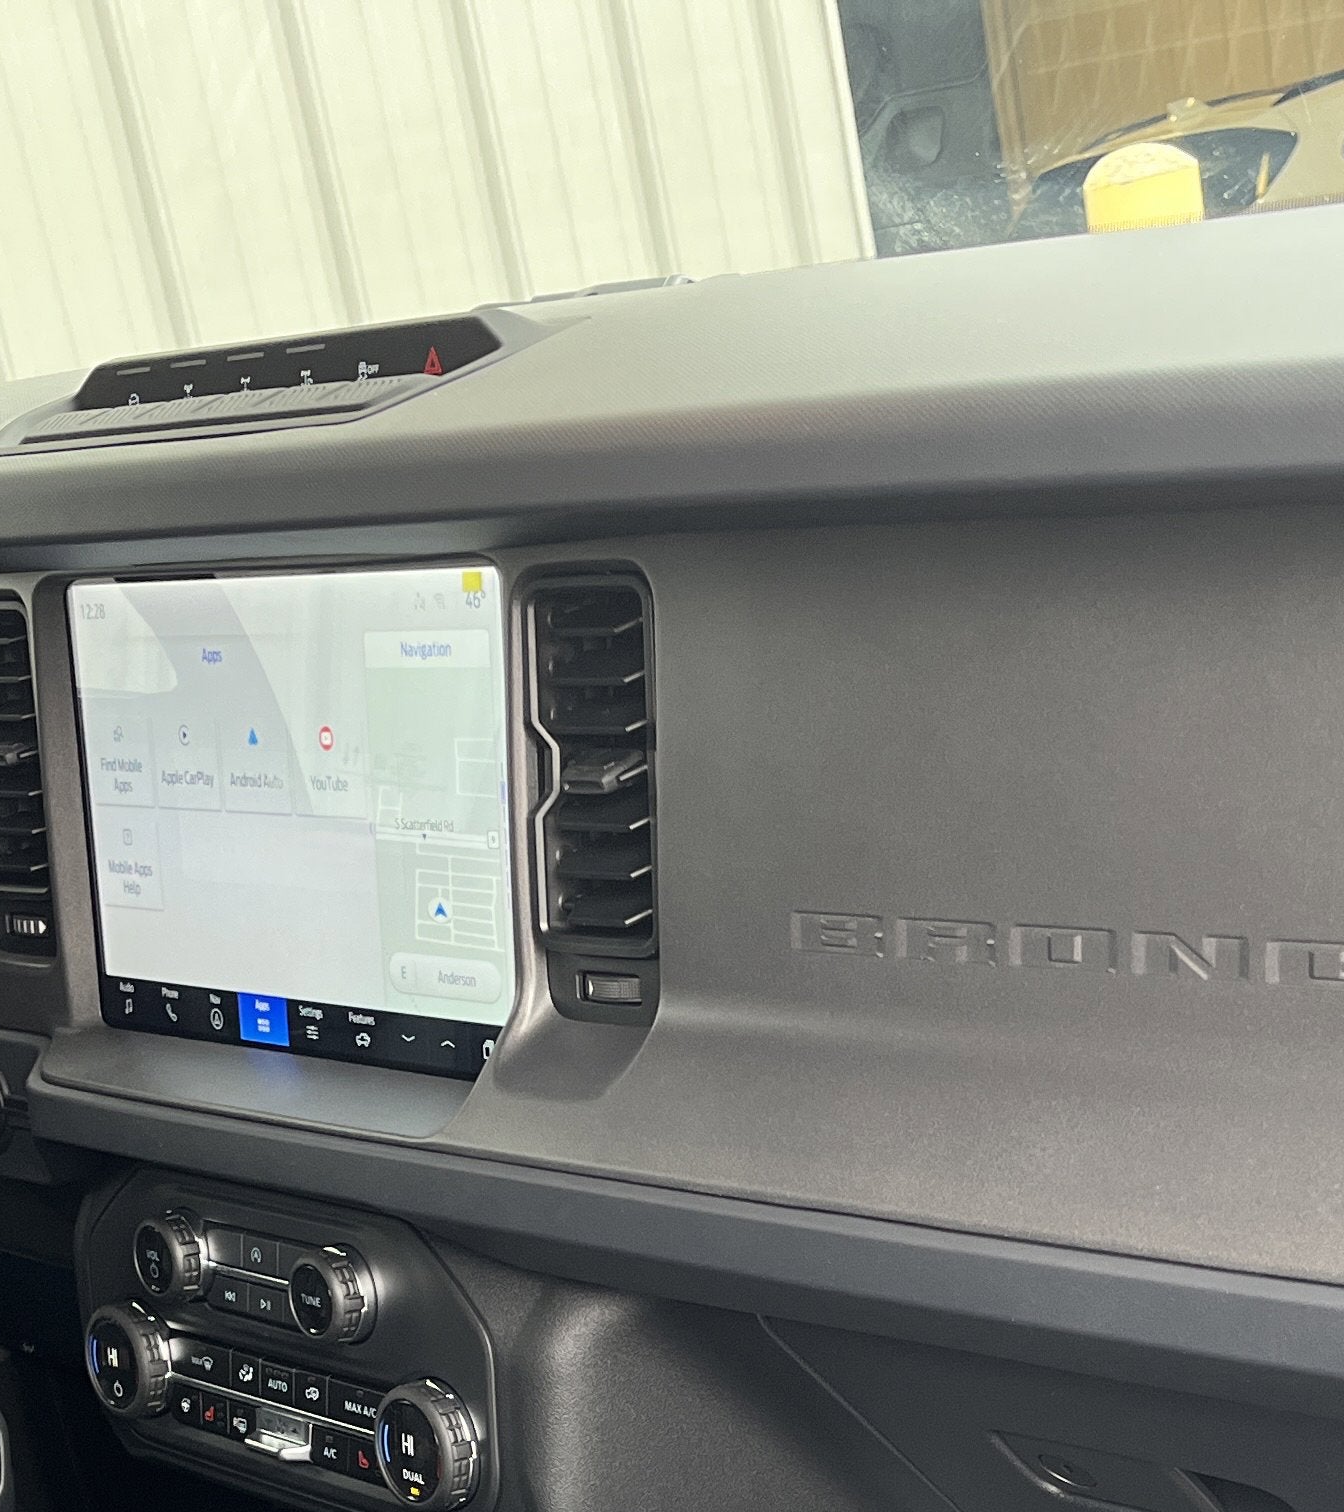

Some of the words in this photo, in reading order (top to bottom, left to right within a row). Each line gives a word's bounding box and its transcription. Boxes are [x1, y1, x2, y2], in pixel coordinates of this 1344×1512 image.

[200, 648, 223, 664] Apps
[399, 641, 452, 660] Navigation
[100, 757, 117, 771] Find
[117, 758, 143, 774] Mobile
[113, 778, 133, 793] Apps
[161, 770, 184, 787] Apple
[184, 771, 214, 788] CarPlay
[229, 772, 262, 788] Android
[263, 774, 284, 789] Auto
[310, 775, 349, 792] YouTube
[108, 859, 133, 875] Mobile
[134, 863, 153, 877] Apps
[123, 881, 141, 896] Help
[438, 969, 476, 988] Anderson
[298, 1004, 324, 1021] Settings
[347, 1011, 376, 1027] Features
[300, 1293, 321, 1308] TUNE
[107, 1346, 119, 1368] HI
[267, 1378, 288, 1393] AUTO
[344, 1400, 362, 1412] MAX
[363, 1405, 377, 1419] A/C
[323, 1446, 337, 1460] A/C
[401, 1432, 415, 1457] HI
[402, 1468, 425, 1485] DUAL
